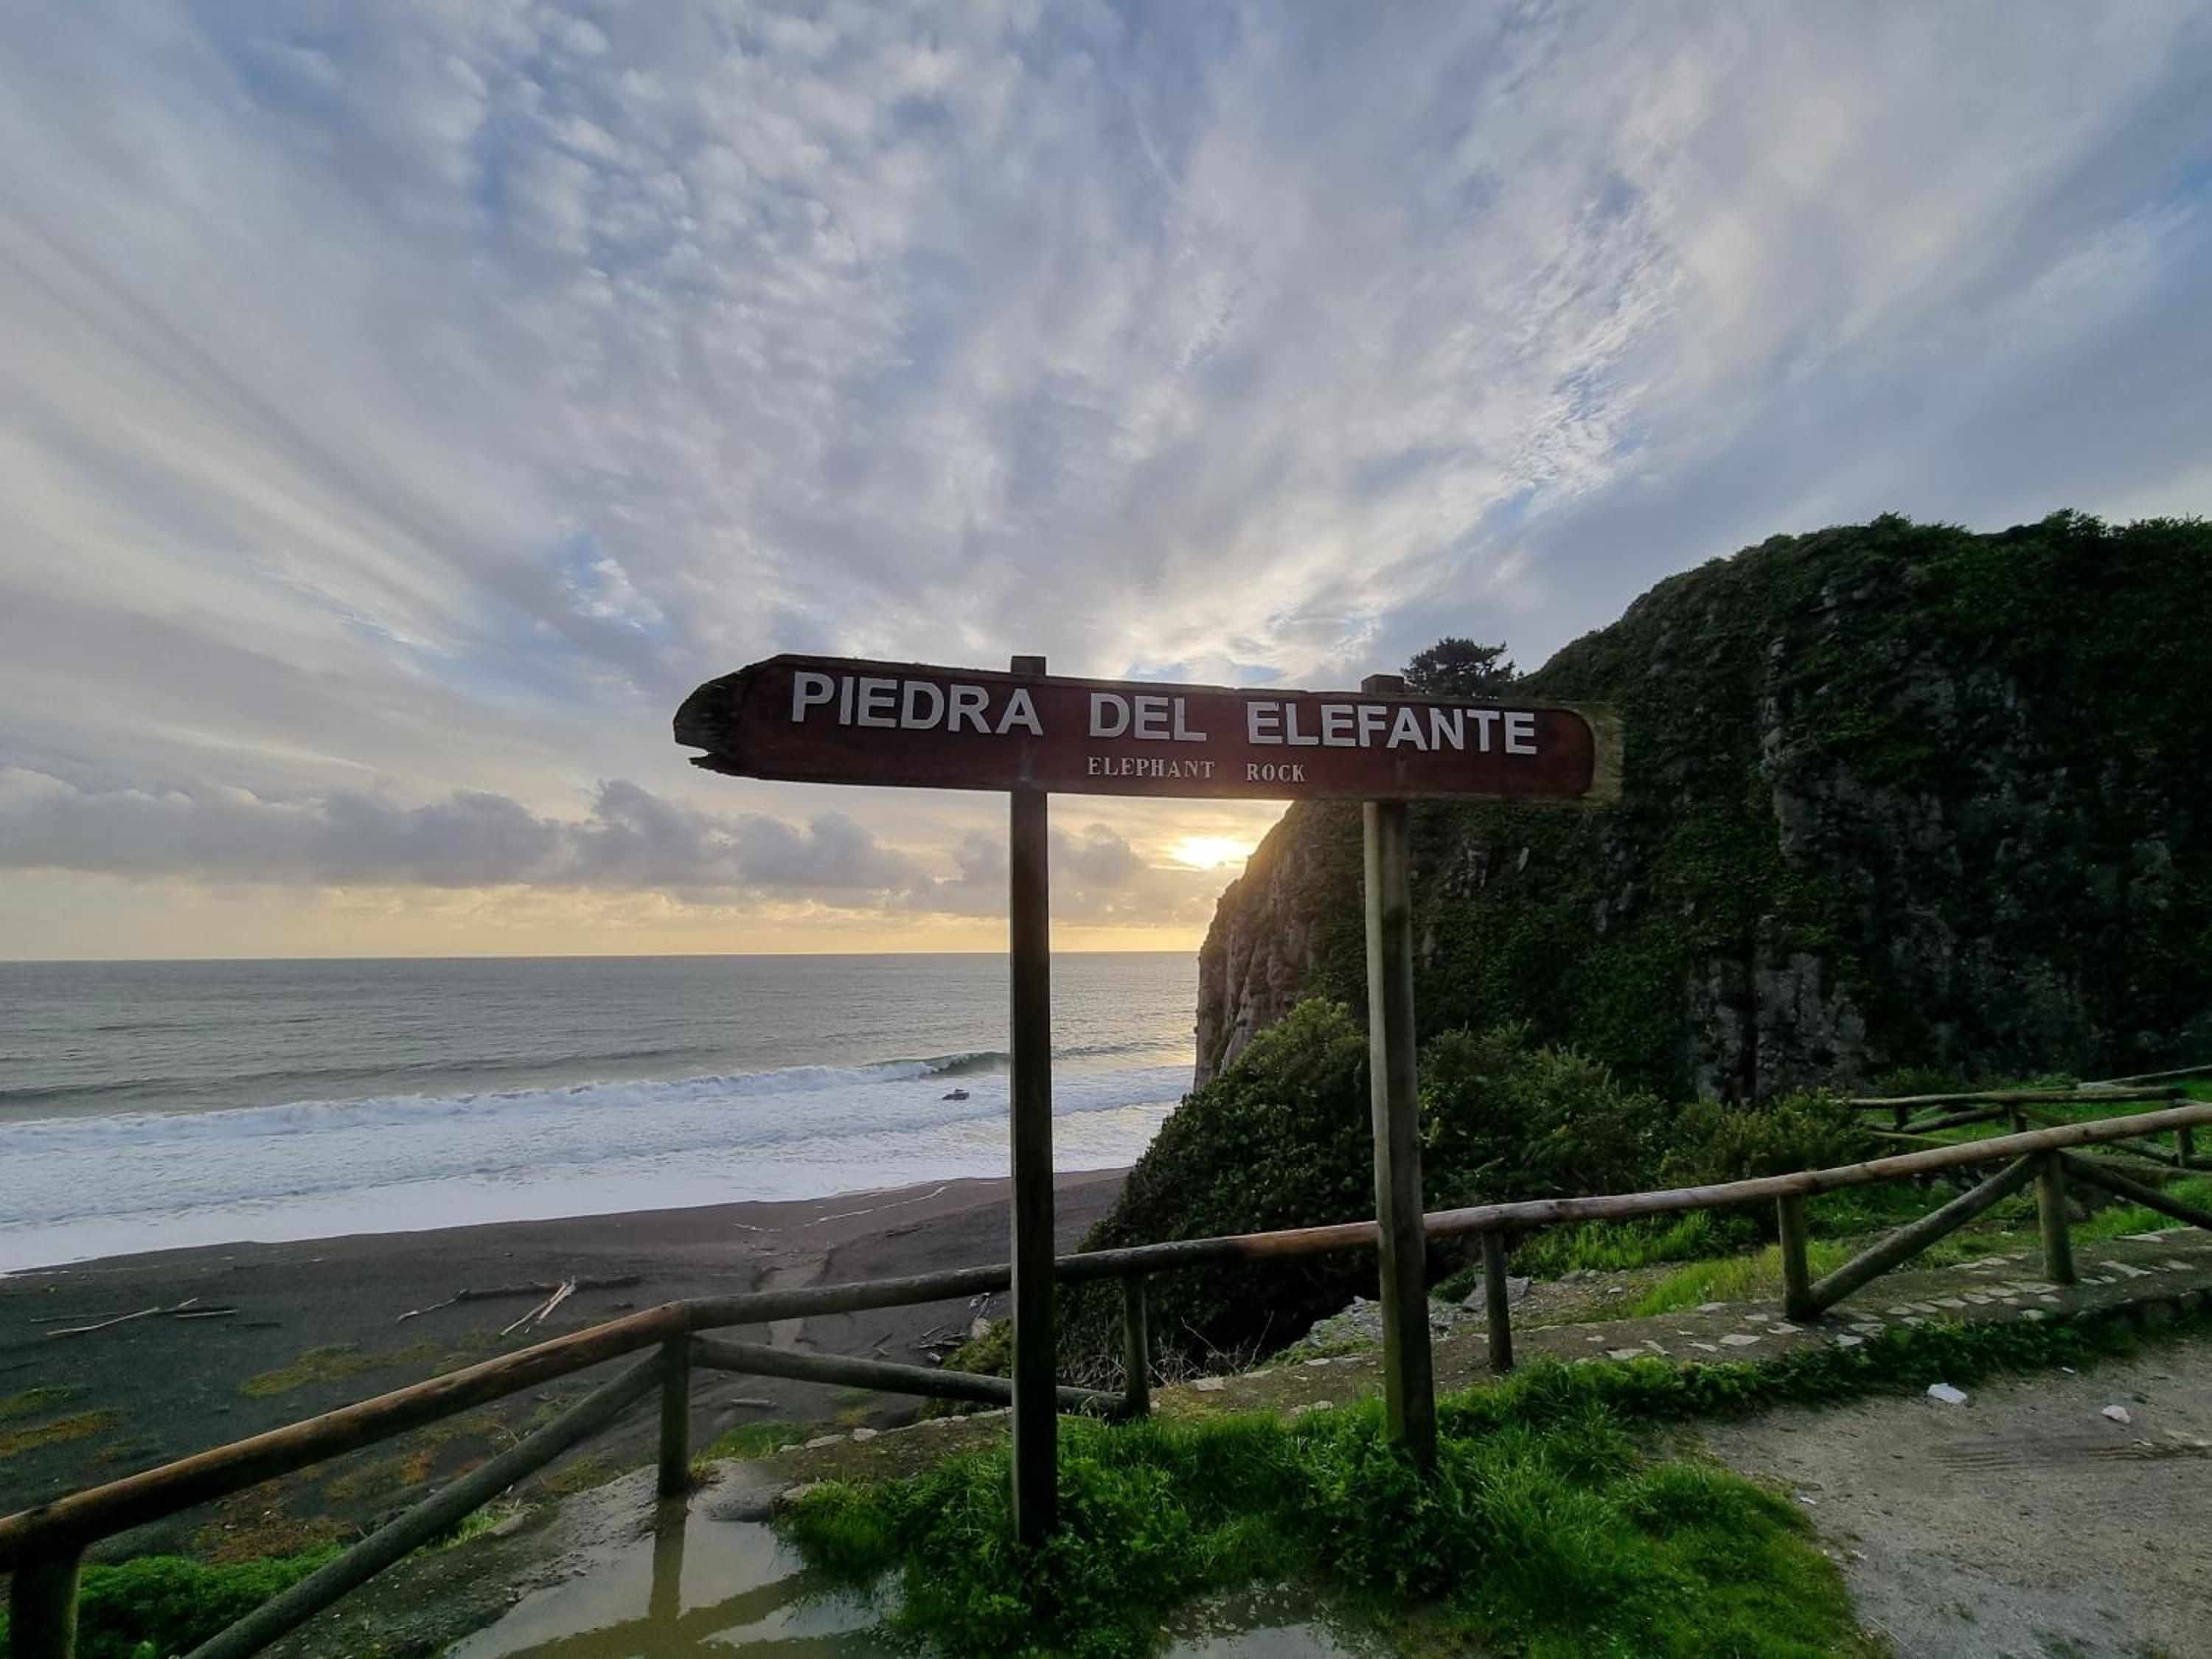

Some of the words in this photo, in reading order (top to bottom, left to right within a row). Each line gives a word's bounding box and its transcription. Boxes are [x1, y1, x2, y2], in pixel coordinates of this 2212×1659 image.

[791, 672, 1044, 736] PIEDRA
[1089, 692, 1207, 742] DEL
[1247, 701, 1538, 756] ELEFANTE
[1088, 757, 1215, 778] ELEPHANT
[1246, 763, 1305, 782] ROCK
